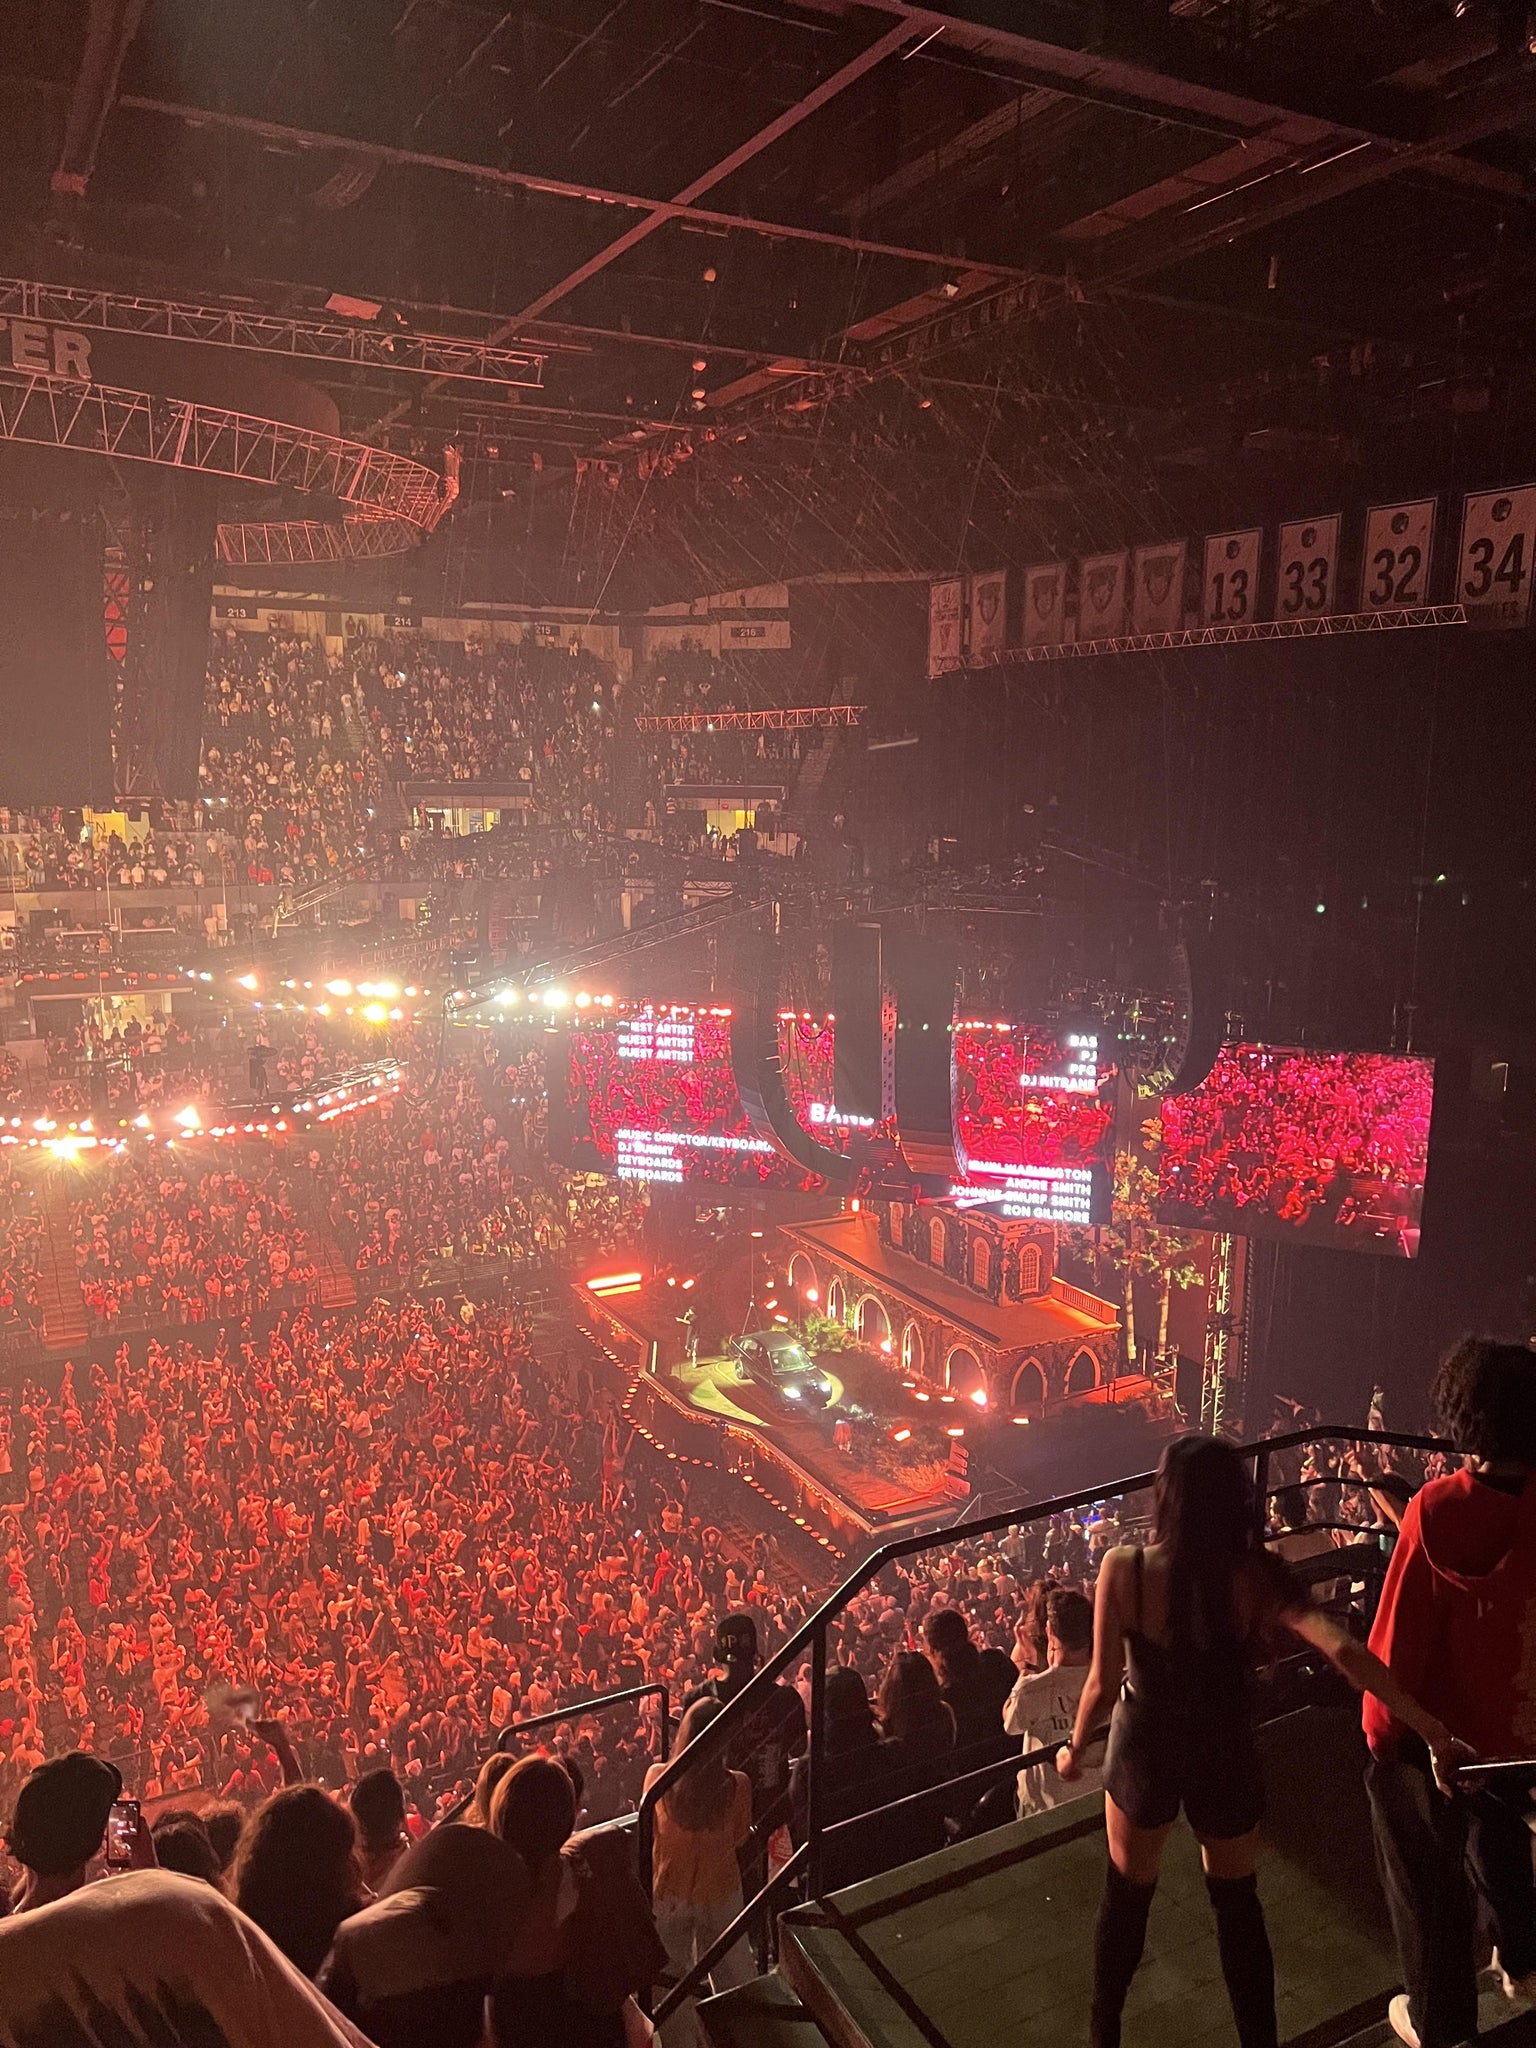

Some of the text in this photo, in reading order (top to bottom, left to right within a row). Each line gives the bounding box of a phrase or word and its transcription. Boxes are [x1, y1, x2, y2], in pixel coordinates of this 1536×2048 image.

[1464, 533, 1526, 598] 34
[1369, 545, 1422, 606] 32
[1282, 557, 1328, 614] 33
[1210, 569, 1248, 622] 13
[227, 608, 247, 618] 213
[394, 616, 412, 627] 214
[535, 626, 551, 635] 215
[656, 1023, 695, 1035] ARTIST
[618, 1034, 695, 1048] GUEST ARTIST
[1069, 1035, 1098, 1048] BAS
[618, 1046, 695, 1062] GUEST ARTIST
[1081, 1050, 1097, 1062] PJ
[1069, 1063, 1097, 1076] PFG
[1020, 1074, 1096, 1091] DJ NITRANE
[617, 1128, 652, 1142] MUSIC
[618, 1141, 632, 1152] DJ
[618, 1154, 683, 1169] KEYBOARDS
[618, 1167, 683, 1182] KEYBOARDS
[1006, 1177, 1091, 1196] ANDRE SMITH
[1051, 1195, 1090, 1209] SMITH
[1003, 1204, 1090, 1224] RON GILMORE
